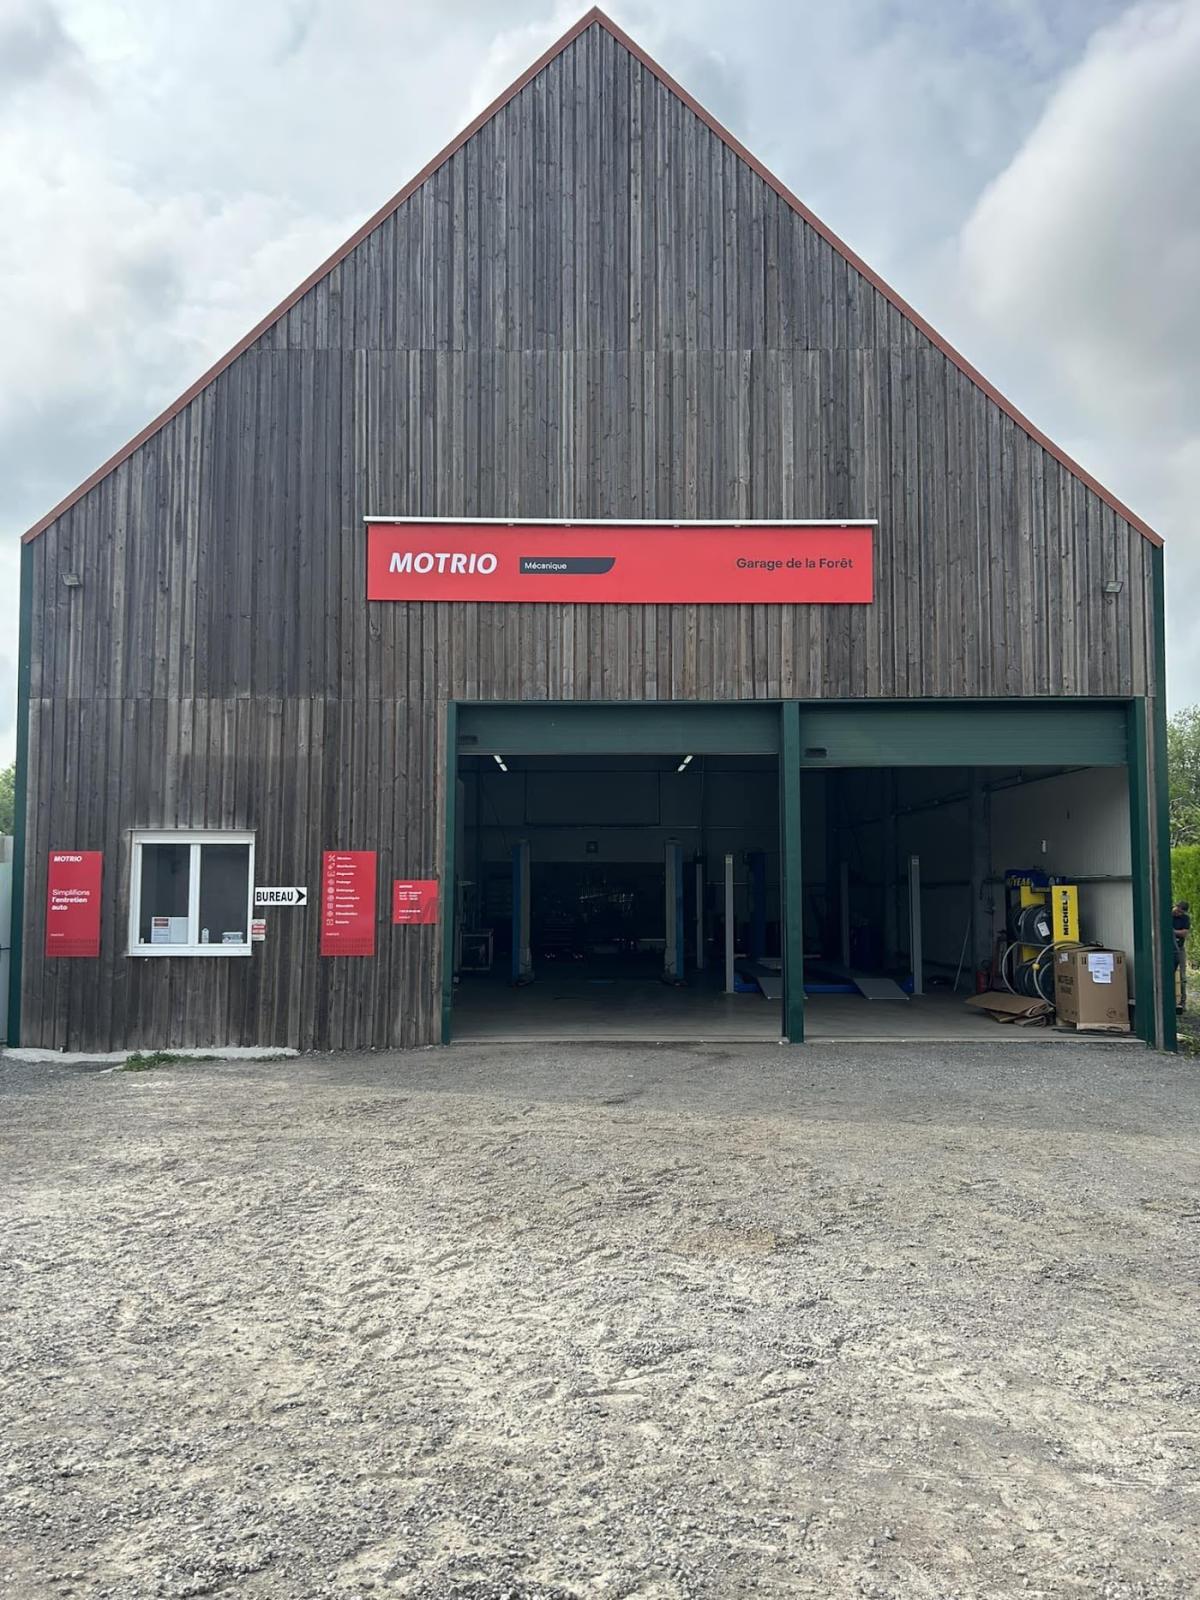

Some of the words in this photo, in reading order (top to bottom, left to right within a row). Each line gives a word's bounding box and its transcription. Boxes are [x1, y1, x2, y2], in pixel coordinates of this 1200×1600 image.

[389, 552, 498, 574] MOTRIO
[524, 561, 568, 571] Mécanique
[736, 558, 783, 571] Garage
[786, 558, 802, 568] de
[805, 558, 816, 568] la
[819, 558, 853, 568] Forêt
[52, 889, 90, 897] Simplifions
[256, 891, 294, 902] BUREAU
